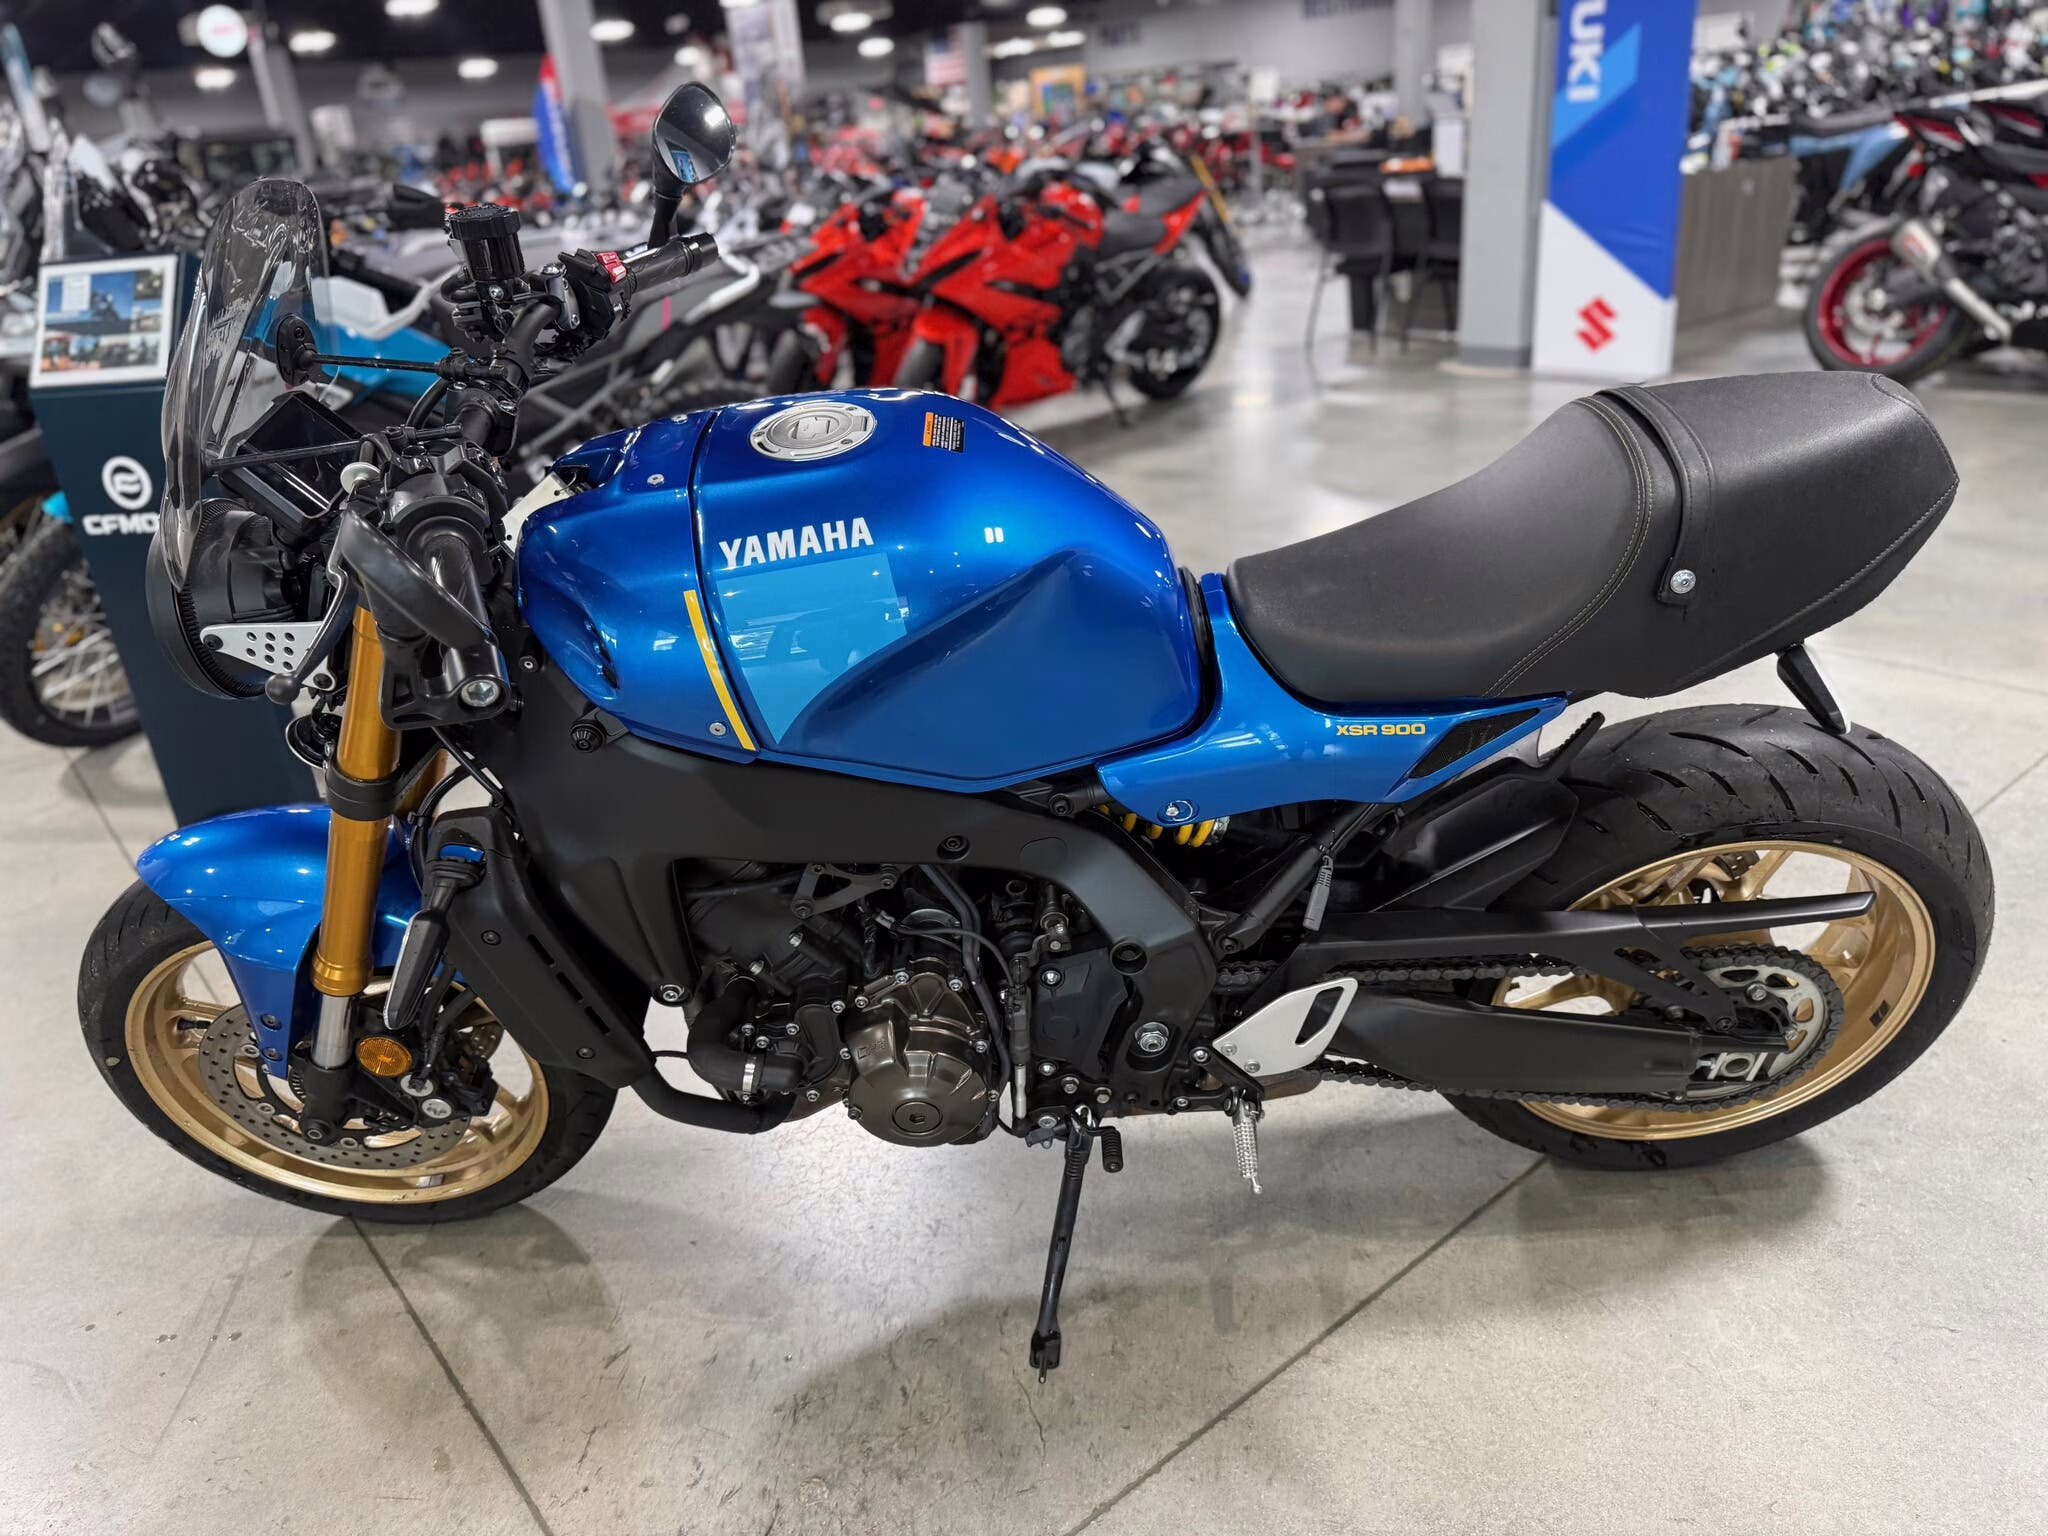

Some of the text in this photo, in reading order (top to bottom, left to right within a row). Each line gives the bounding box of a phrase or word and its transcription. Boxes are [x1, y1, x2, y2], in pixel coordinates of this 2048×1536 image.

[719, 517, 874, 569] YAMAHA
[1336, 723, 1426, 736] XSR 900
